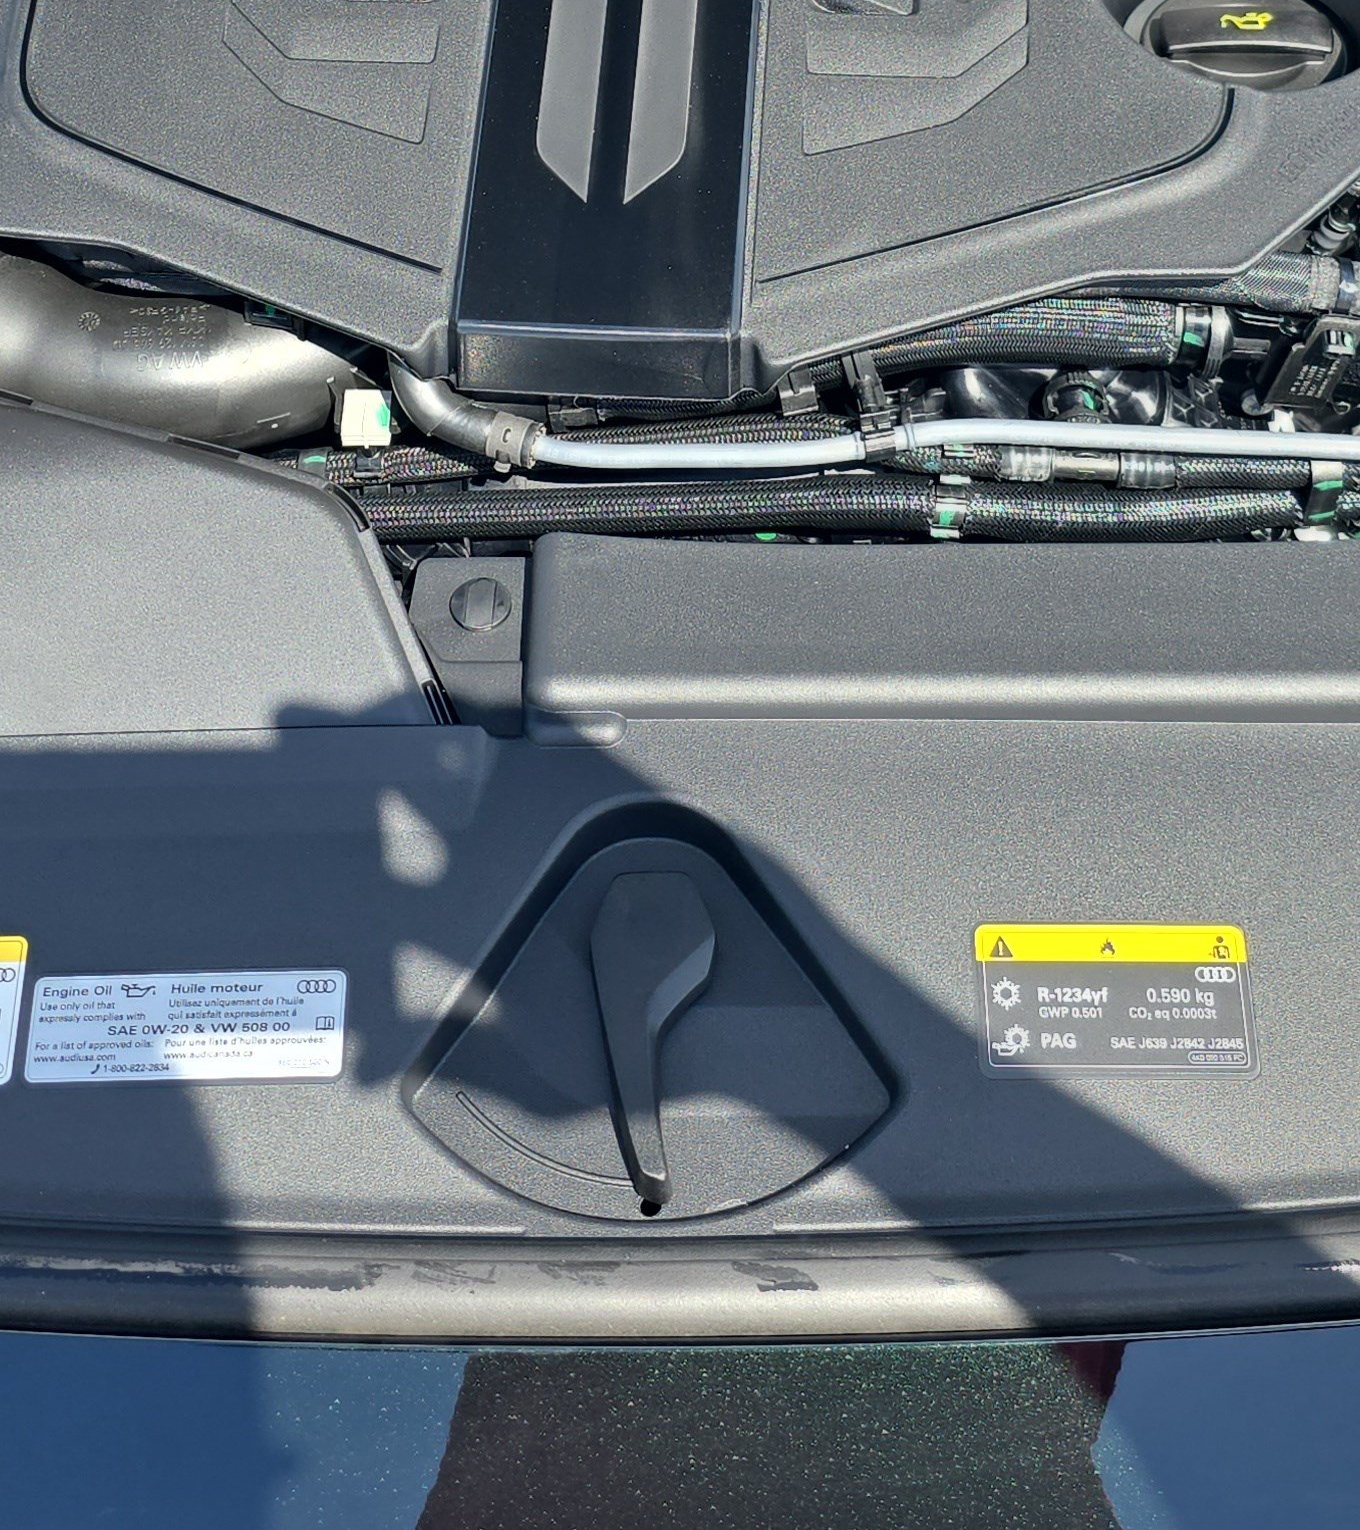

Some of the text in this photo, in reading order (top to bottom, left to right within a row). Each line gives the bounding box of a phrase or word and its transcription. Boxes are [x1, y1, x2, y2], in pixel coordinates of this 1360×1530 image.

[136, 350, 204, 372] VW AG
[43, 985, 113, 1000] Engine Oil
[171, 983, 264, 994] Huile moteur
[169, 998, 202, 1008] Utilisez
[204, 997, 261, 1008] uniquement
[262, 997, 274, 1006] de
[1037, 986, 1215, 1007] R-1234yf 0.590 kg
[40, 1001, 116, 1012] Use only oil that
[38, 1011, 146, 1024] expressly complies with
[168, 1011, 183, 1021] qui
[185, 1010, 222, 1019] satisfait
[1039, 1007, 1069, 1019] GWP
[1071, 1007, 1103, 1019] 0.501
[1154, 1009, 1170, 1022] eq
[107, 1021, 291, 1037] SAE 0W-20 & VW 508 00
[35, 1041, 50, 1051] For
[61, 1041, 75, 1050] list
[77, 1041, 87, 1050] of
[88, 1040, 132, 1051] approved
[164, 1038, 187, 1048] Pour
[189, 1039, 206, 1047] une
[209, 1037, 228, 1046] liste
[1041, 1033, 1244, 1049] PAG SAE J639 J2842 J2845
[33, 1052, 117, 1063] www.audiusa.com
